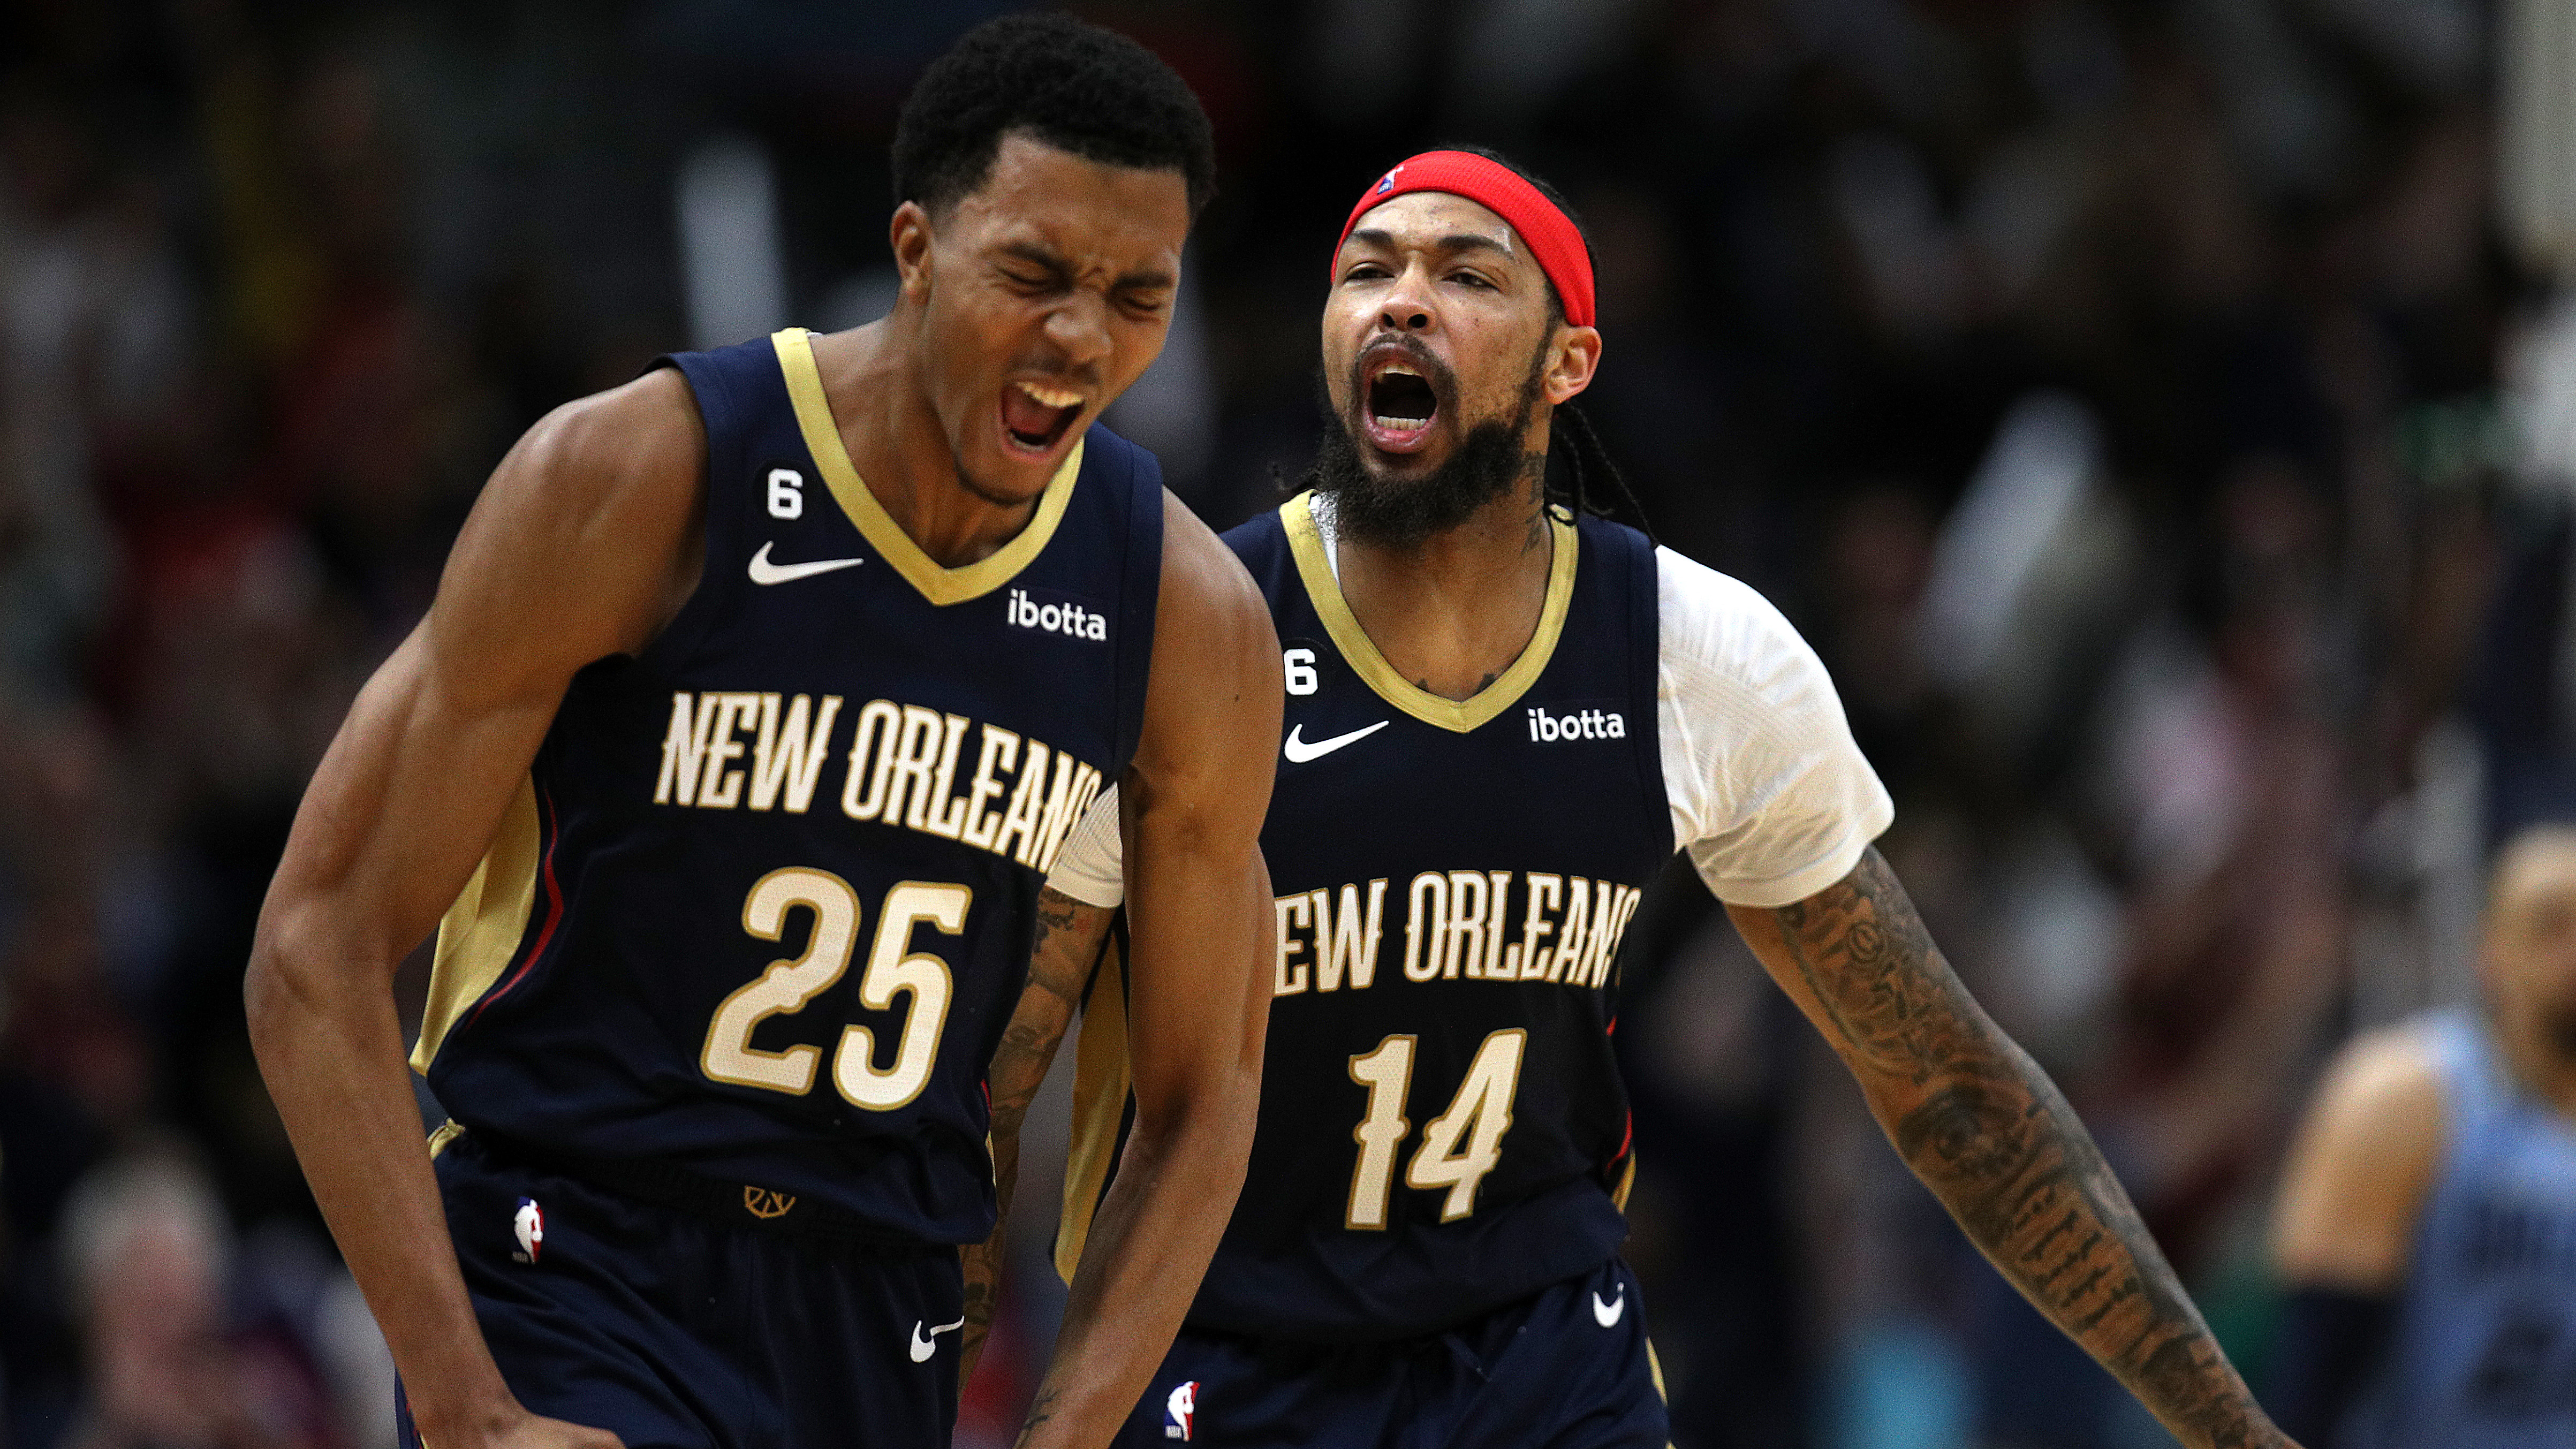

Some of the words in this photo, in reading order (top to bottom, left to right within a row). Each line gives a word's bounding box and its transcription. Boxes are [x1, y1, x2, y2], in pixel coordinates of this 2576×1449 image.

[767, 469, 803, 520] 6
[1007, 588, 1107, 641] ibotta
[1283, 648, 1318, 695] 6
[653, 690, 844, 813] NEW
[1527, 708, 1626, 742] ibotta
[1274, 877, 1389, 997] EW
[699, 865, 973, 1112] 25
[1344, 1027, 1528, 1231] 14
